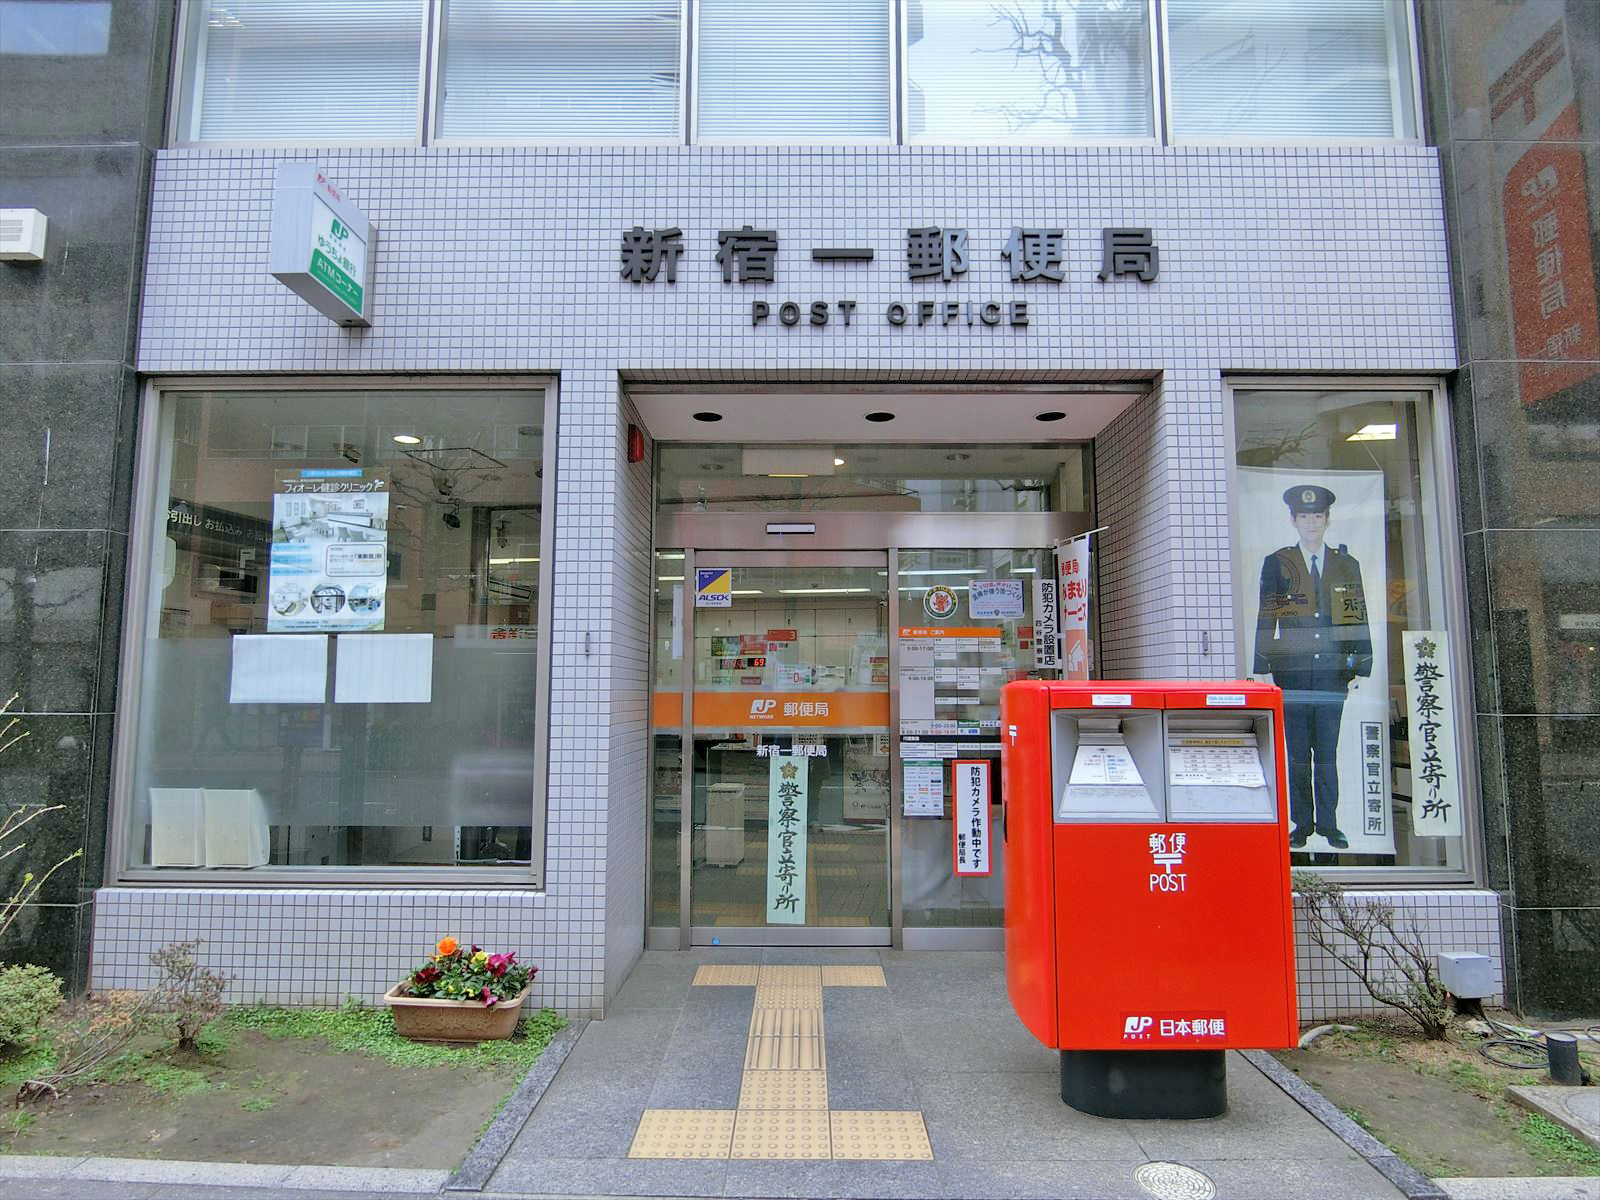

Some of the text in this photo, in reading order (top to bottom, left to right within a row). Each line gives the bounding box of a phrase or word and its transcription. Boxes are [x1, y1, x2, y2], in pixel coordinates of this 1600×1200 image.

[317, 233, 357, 278] ゆうちょ銀行
[620, 225, 1160, 283] 新宿一郵便局
[316, 257, 359, 297] ATMコーナー
[752, 300, 1030, 326] POST OFFICE
[284, 482, 373, 493] フィオーレ健診クリニック
[789, 631, 796, 640] 3
[1041, 582, 1056, 666] 防犯カメラ設置店
[754, 658, 765, 667] 69
[751, 699, 829, 717] JP 郵便局
[756, 744, 828, 757] 新宿一郵便局
[1413, 662, 1452, 823] 警察官立寄り所
[1364, 725, 1382, 831] 警察官立寄所
[970, 766, 982, 869] 防犯カメラ作動中です
[772, 781, 804, 914] 警察官立寄り所
[958, 833, 966, 864] 郵便局長
[1148, 832, 1187, 854] 郵便
[1149, 873, 1187, 891] POST
[1124, 1016, 1225, 1036] JP 日本郵便
